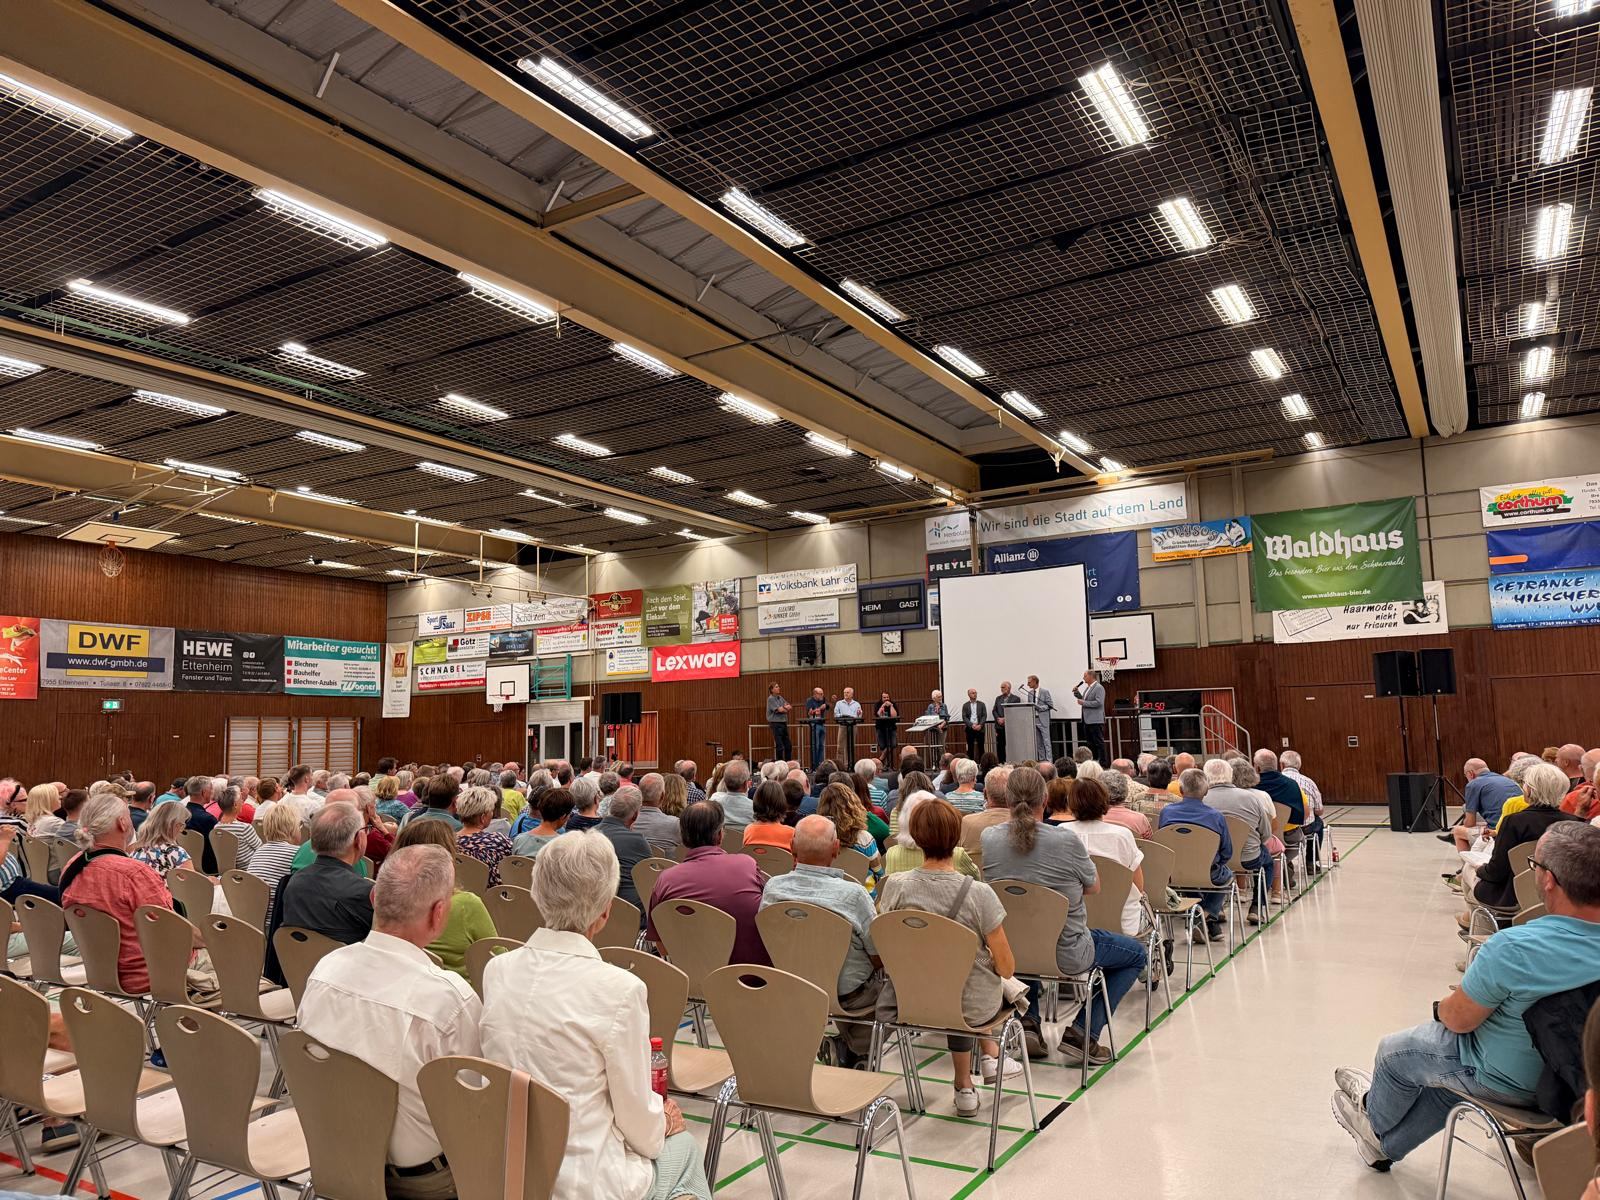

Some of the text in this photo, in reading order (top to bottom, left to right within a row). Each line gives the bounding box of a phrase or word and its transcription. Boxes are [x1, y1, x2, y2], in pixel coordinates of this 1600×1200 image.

[1497, 495, 1563, 511] corthum
[980, 495, 1184, 533] Wir sind die Stadt auf dem Land
[1503, 508, 1554, 518] www.corthum.de
[1264, 528, 1404, 562] Waldhaus
[994, 552, 1026, 564] Allianz
[1315, 564, 1330, 575] Bier
[1345, 562, 1359, 572] dem
[774, 573, 856, 592] Volksbank Lahr eG
[1301, 588, 1371, 600] www.waldhaus-bier.de
[668, 603, 682, 611] dem
[861, 603, 882, 612] HEIM
[899, 600, 920, 609] GAST
[466, 610, 492, 623] ZIPSE
[1375, 612, 1397, 622] nicht
[1346, 620, 1398, 631] nur Frisuren
[78, 631, 142, 651] DWF
[460, 637, 476, 647] Götz
[183, 640, 233, 658] HEWE
[287, 639, 377, 656] Mitarbeiter gesucht!
[68, 658, 149, 669] www.dwf-gmbh.de
[182, 660, 233, 672] Ettenheim
[294, 660, 319, 669] Blechner
[656, 651, 737, 672] Lexware
[294, 669, 322, 678] Bauhelfer
[420, 664, 466, 675] SCHNABEL
[181, 673, 204, 681] Fenster
[216, 674, 233, 682] Türen
[293, 678, 339, 688] Blechner-Azubis
[342, 680, 377, 692] Wagner
